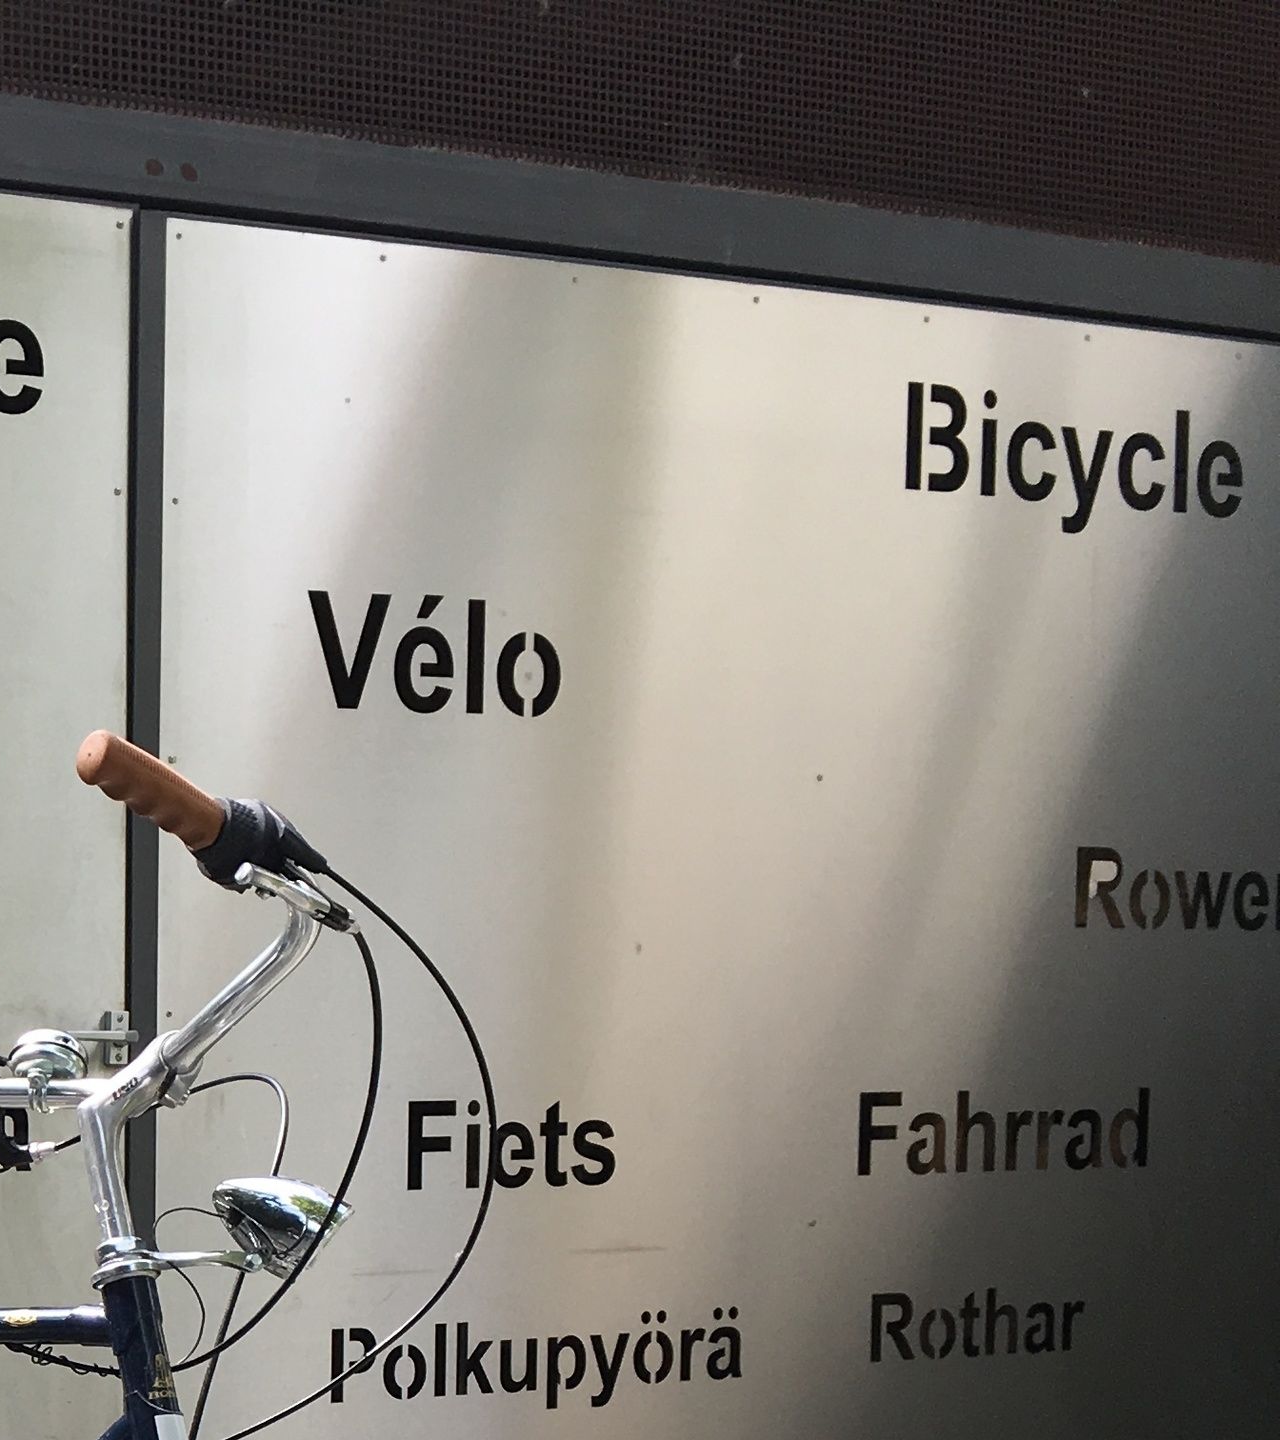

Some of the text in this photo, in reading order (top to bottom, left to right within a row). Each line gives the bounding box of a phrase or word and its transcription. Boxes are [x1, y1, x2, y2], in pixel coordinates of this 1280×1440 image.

[905, 380, 1244, 534] Bicycle
[307, 589, 562, 718] Vélo
[1075, 846, 1280, 931] Rowe
[406, 1100, 616, 1191] Fiets
[856, 1087, 1152, 1177] Fahrrad
[329, 1306, 744, 1410] Polkupyörä
[869, 1287, 1086, 1364] Rothar
